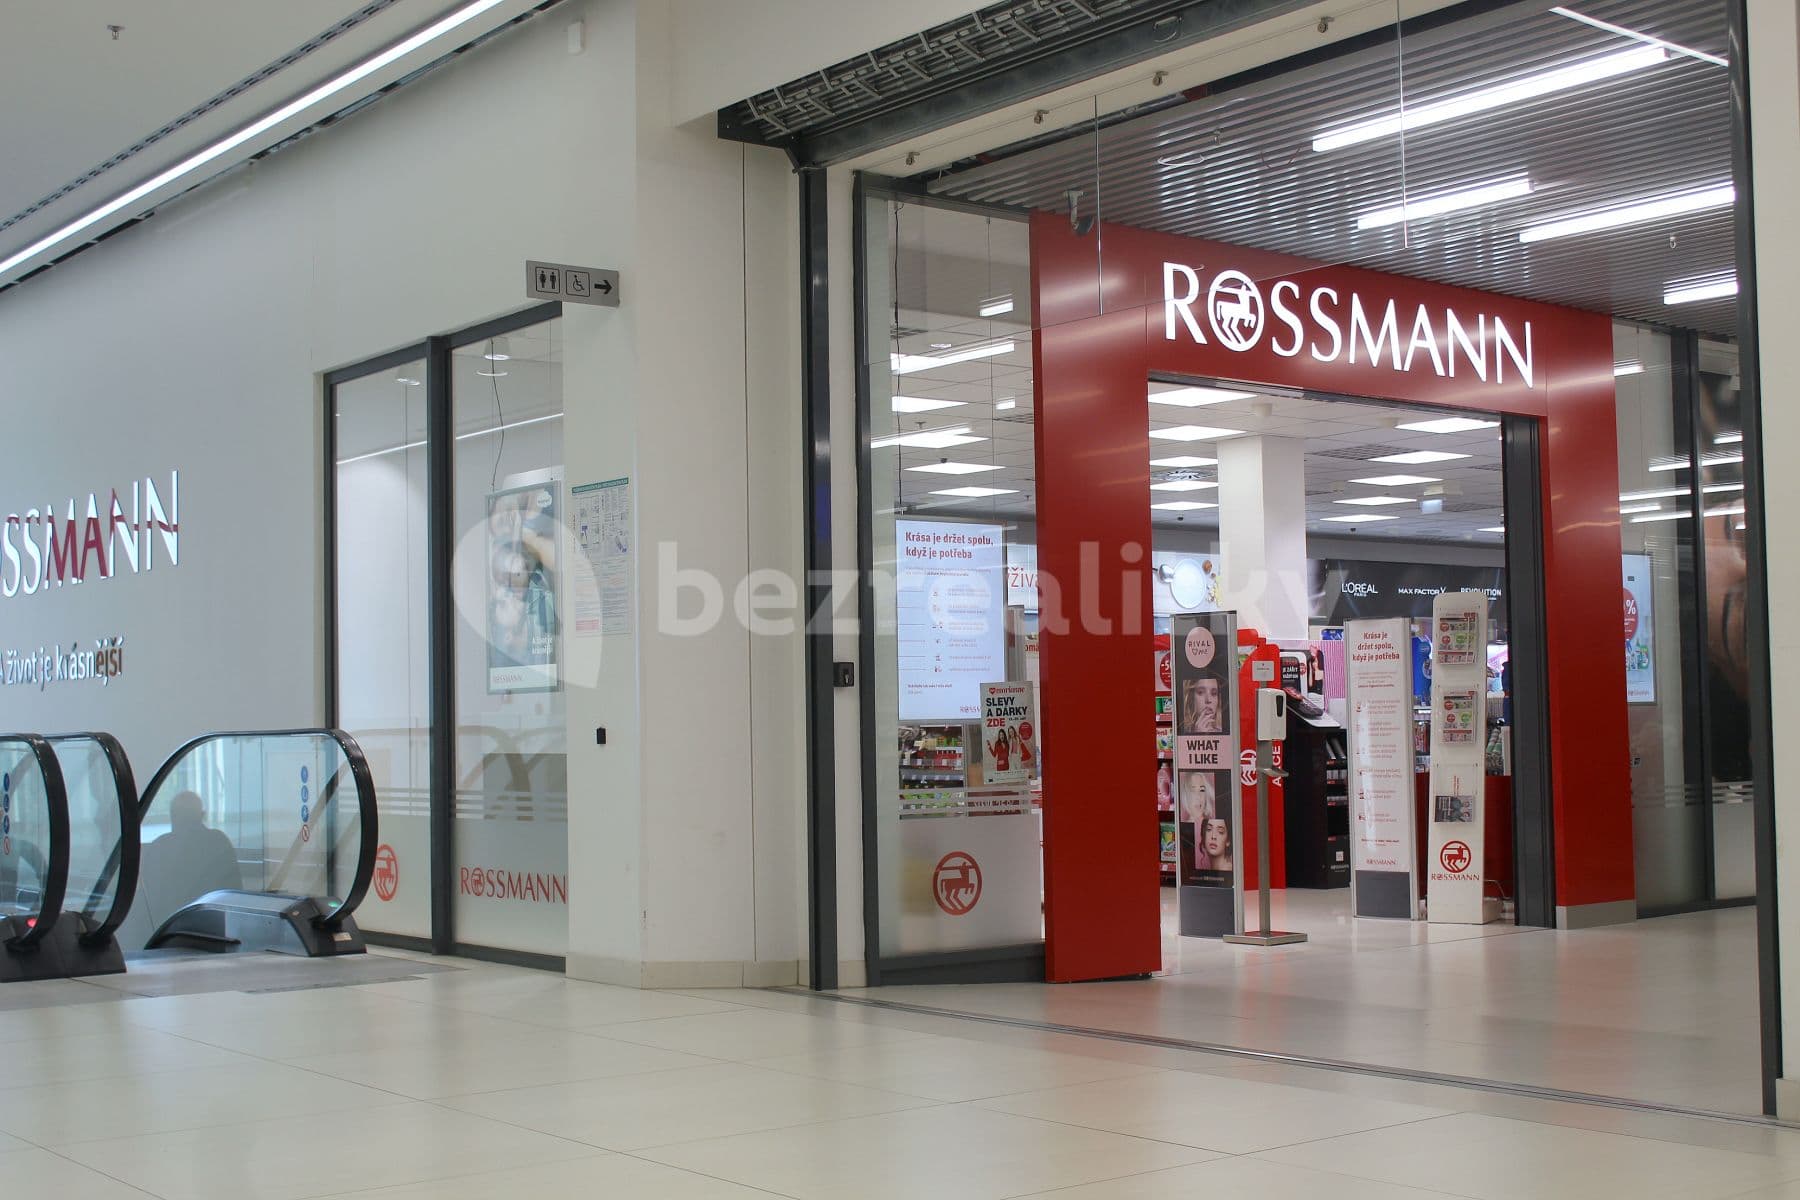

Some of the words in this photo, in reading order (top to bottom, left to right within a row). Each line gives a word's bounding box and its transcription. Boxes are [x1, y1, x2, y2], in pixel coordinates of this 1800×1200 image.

[1163, 262, 1534, 389] ROSSMANN
[0, 470, 178, 598] SSMANN
[905, 531, 931, 542] Krása
[933, 532, 941, 545] je
[943, 533, 965, 544] držet
[968, 535, 994, 547] spolu,
[906, 546, 927, 559] když
[929, 547, 937, 559] je
[940, 548, 972, 560] potřeba
[1006, 566, 1038, 588] živ
[1363, 632, 1381, 640] Krása
[1382, 631, 1388, 640] je
[1188, 640, 1211, 648] RIVAL
[1352, 653, 1367, 662] když
[1368, 653, 1374, 662] je
[1375, 652, 1400, 662] potřeba
[7, 650, 38, 685] život
[40, 647, 53, 692] je
[56, 636, 124, 687] krásnější
[1161, 660, 1172, 671] -5
[986, 696, 1015, 707] SLEVY
[987, 708, 993, 717] A
[986, 717, 1006, 728] ZDE
[1187, 740, 1220, 751] WHAT
[1194, 753, 1219, 764] LIKE
[1272, 745, 1282, 787] ACE
[1431, 873, 1480, 881] ROSSMANN
[460, 867, 566, 904] ROSSMANN
